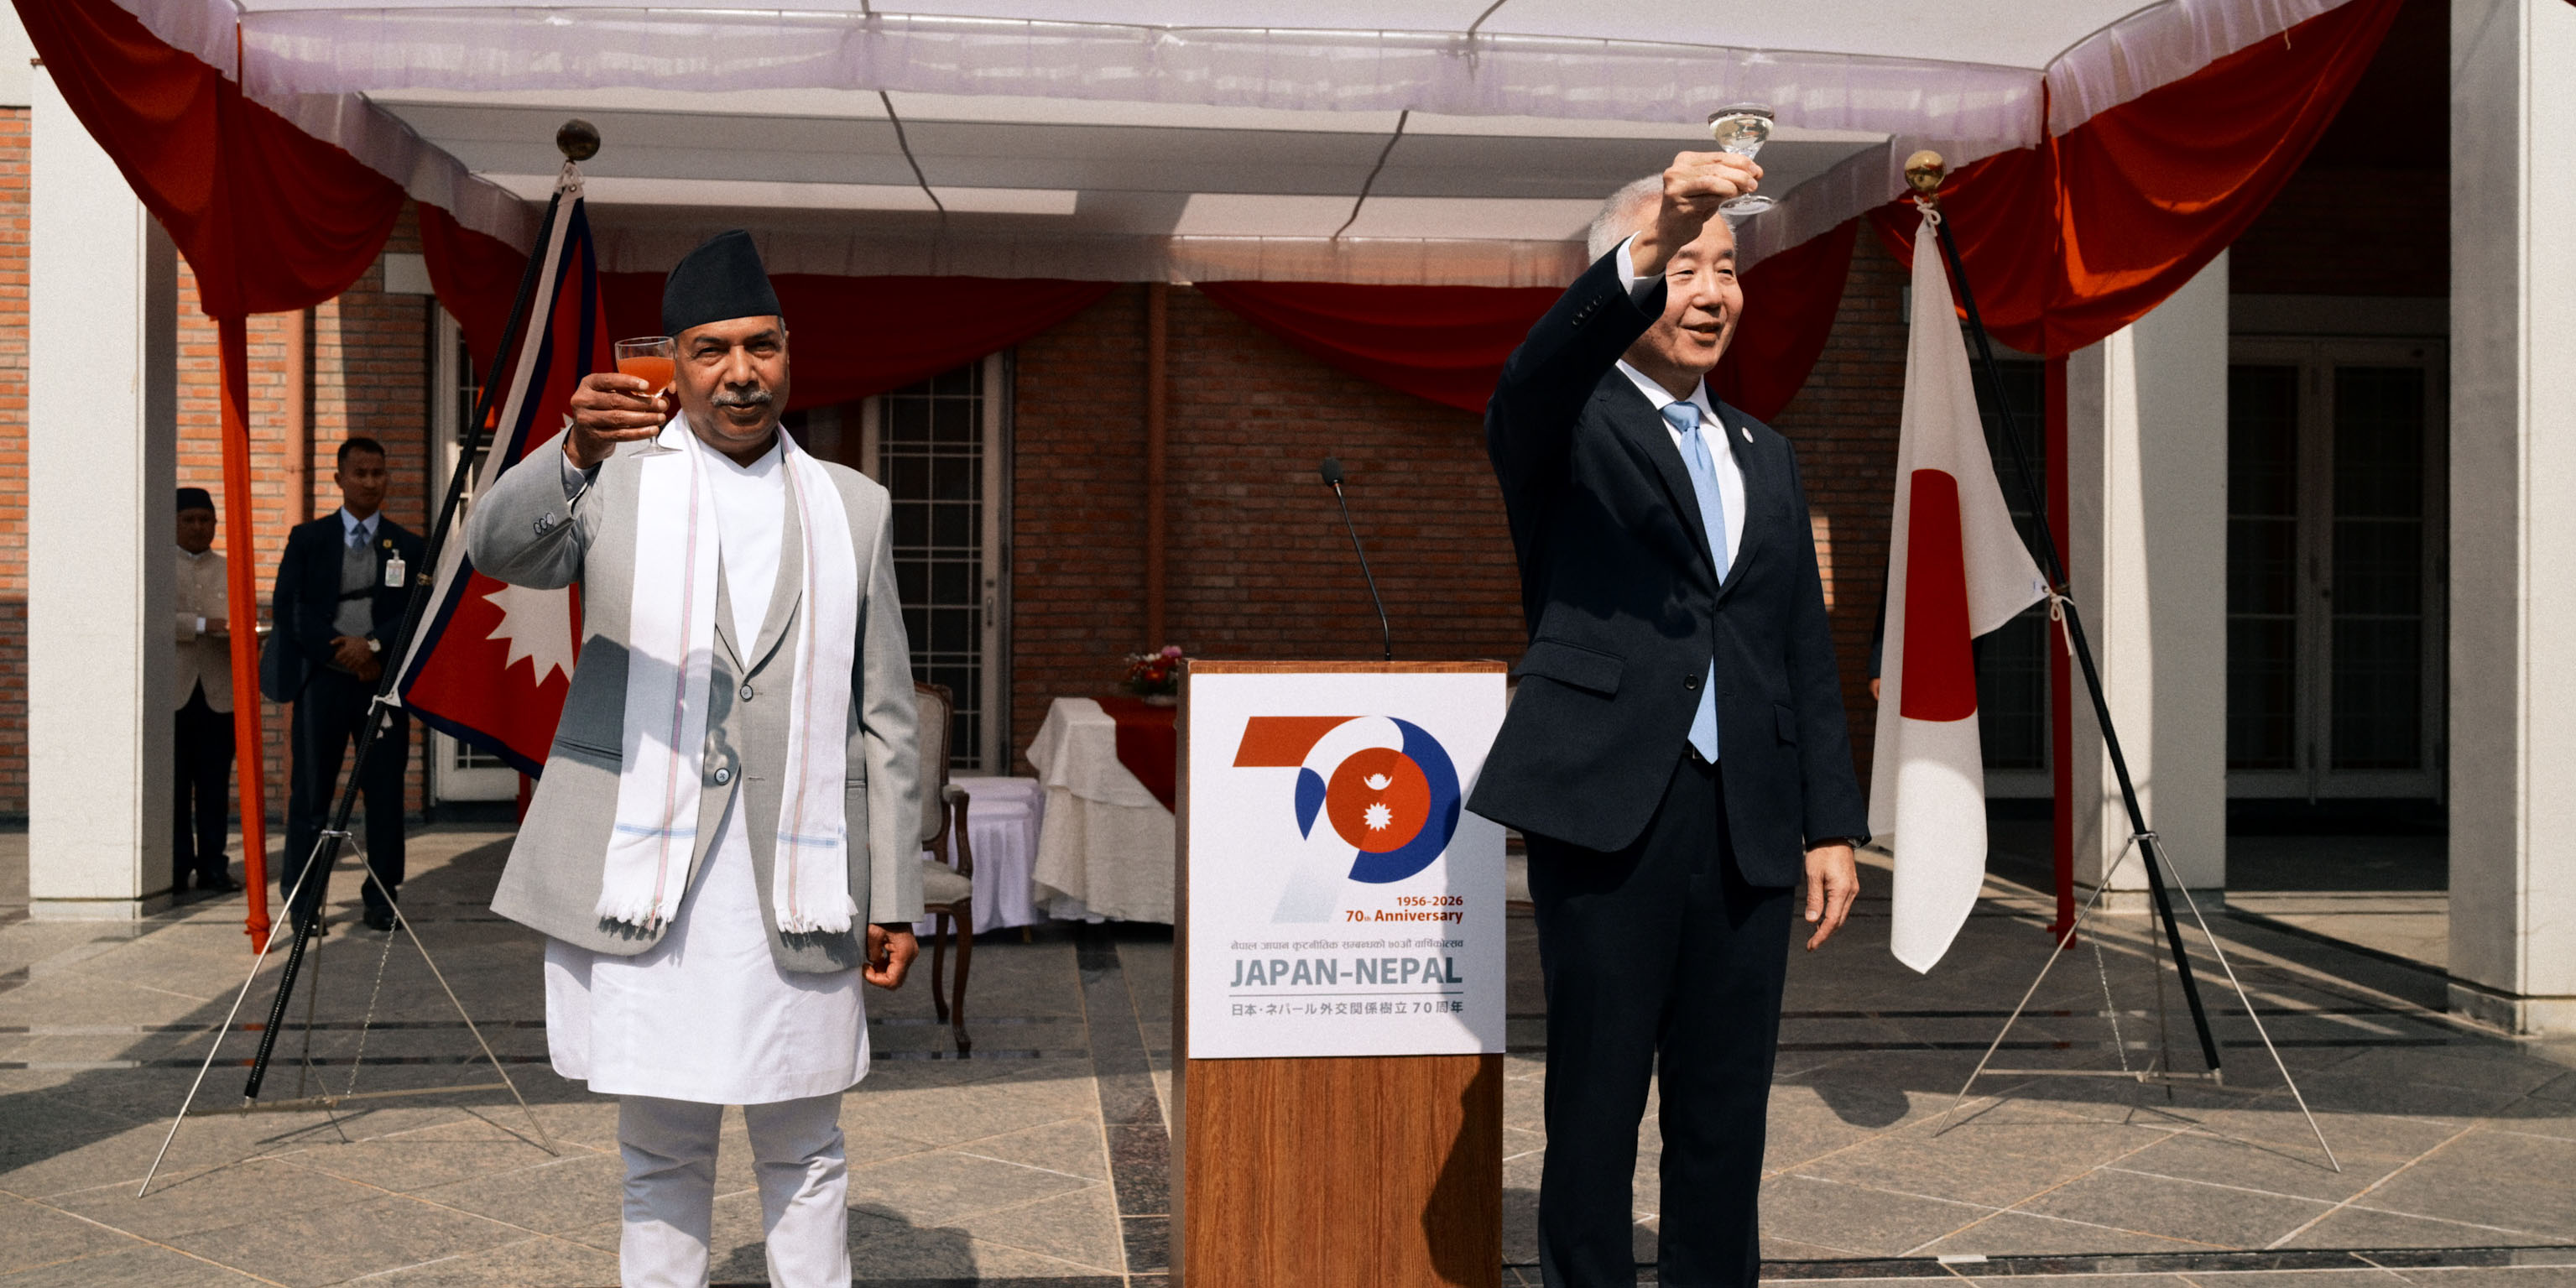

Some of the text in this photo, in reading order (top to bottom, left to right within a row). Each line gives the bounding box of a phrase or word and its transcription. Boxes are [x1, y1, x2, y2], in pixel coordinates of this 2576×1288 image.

[1396, 895, 1463, 907] 1956-2026
[1345, 909, 1463, 925] 70th Anniversary
[1230, 940, 1258, 951] नेपाल
[1230, 957, 1463, 988] JAPAN-NEPAL
